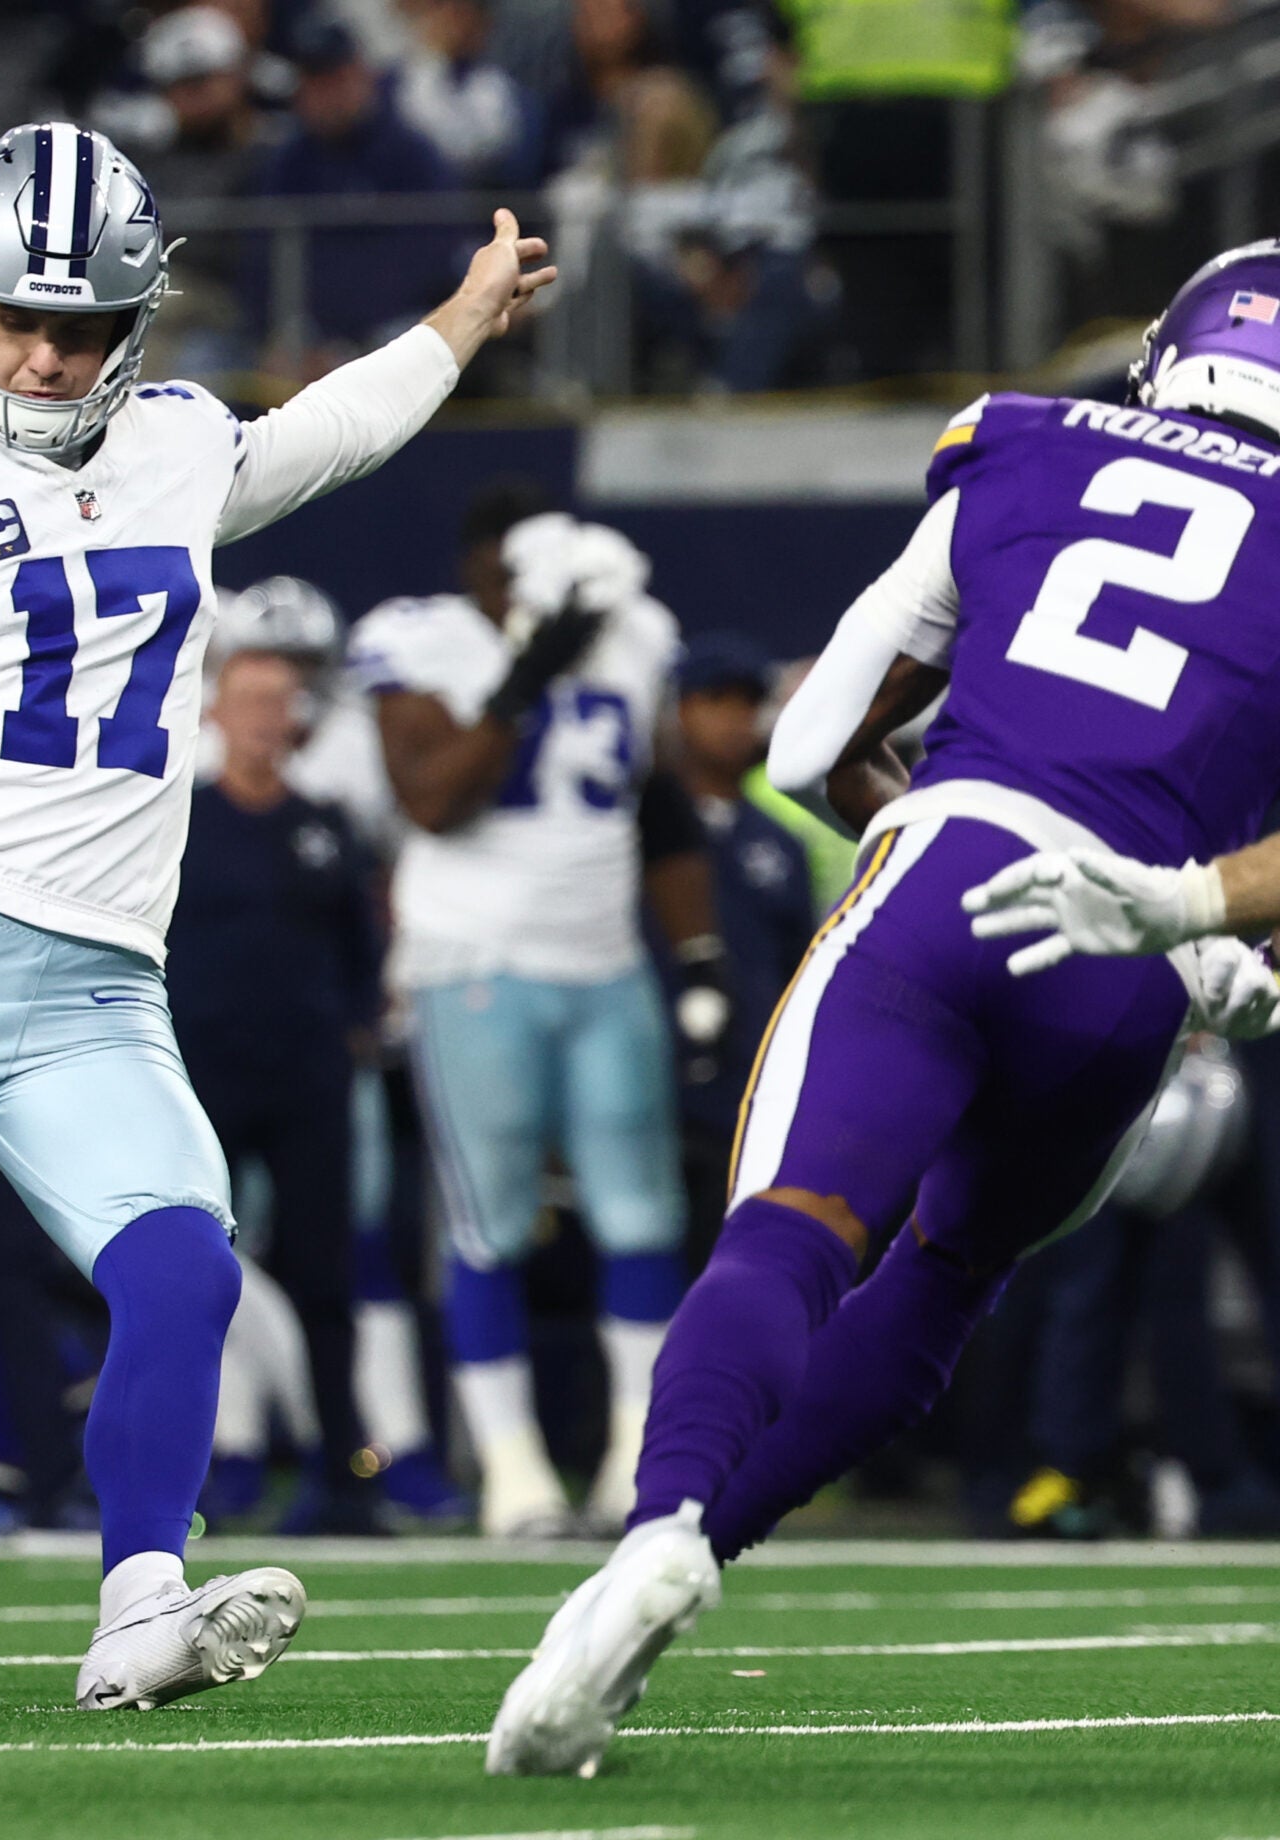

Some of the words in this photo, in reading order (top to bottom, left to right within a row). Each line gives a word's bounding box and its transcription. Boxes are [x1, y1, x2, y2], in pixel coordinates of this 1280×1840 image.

[29, 281, 82, 295] COWBOYS
[0, 546, 201, 780] 17
[1005, 456, 1256, 712] 2
